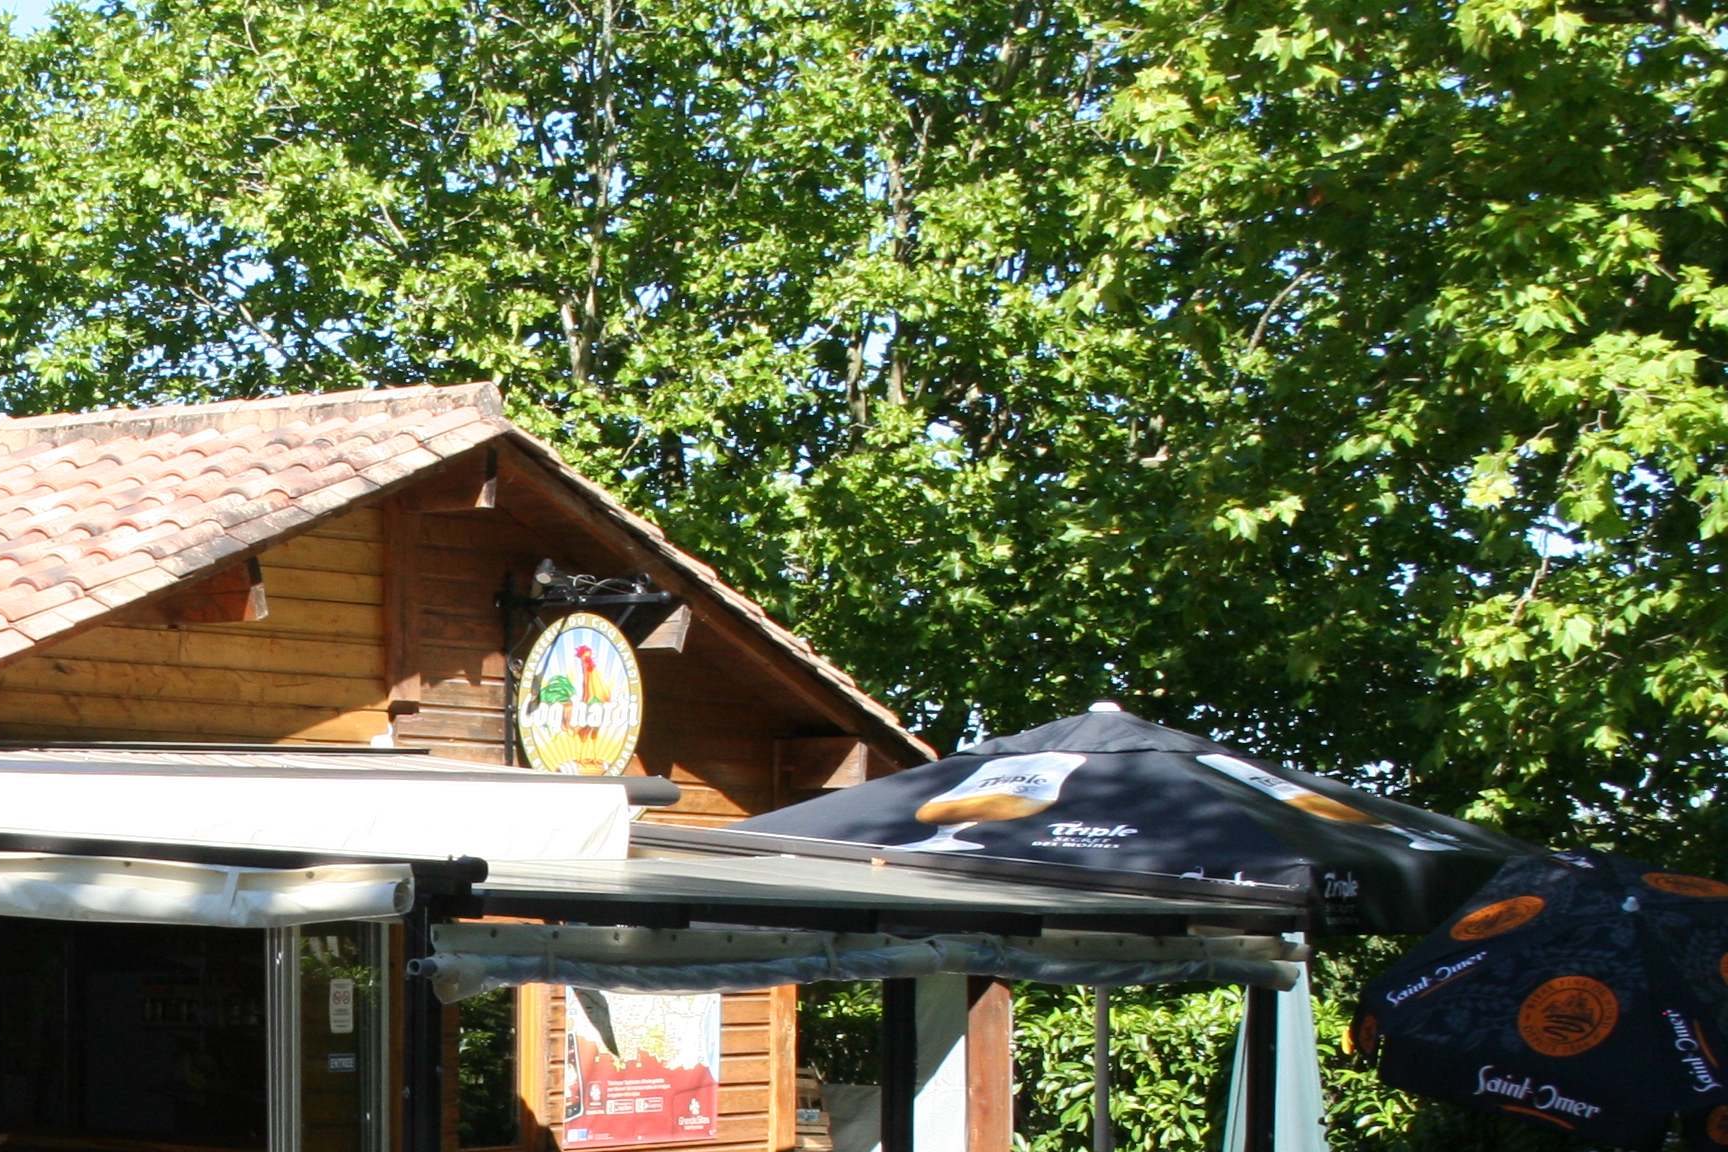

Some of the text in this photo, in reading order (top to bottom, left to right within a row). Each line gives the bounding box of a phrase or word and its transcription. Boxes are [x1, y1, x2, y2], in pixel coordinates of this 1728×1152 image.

[568, 615, 586, 626] DU
[591, 618, 616, 641] COQ
[616, 640, 639, 685] HARDI
[1046, 820, 1139, 838] Triple
